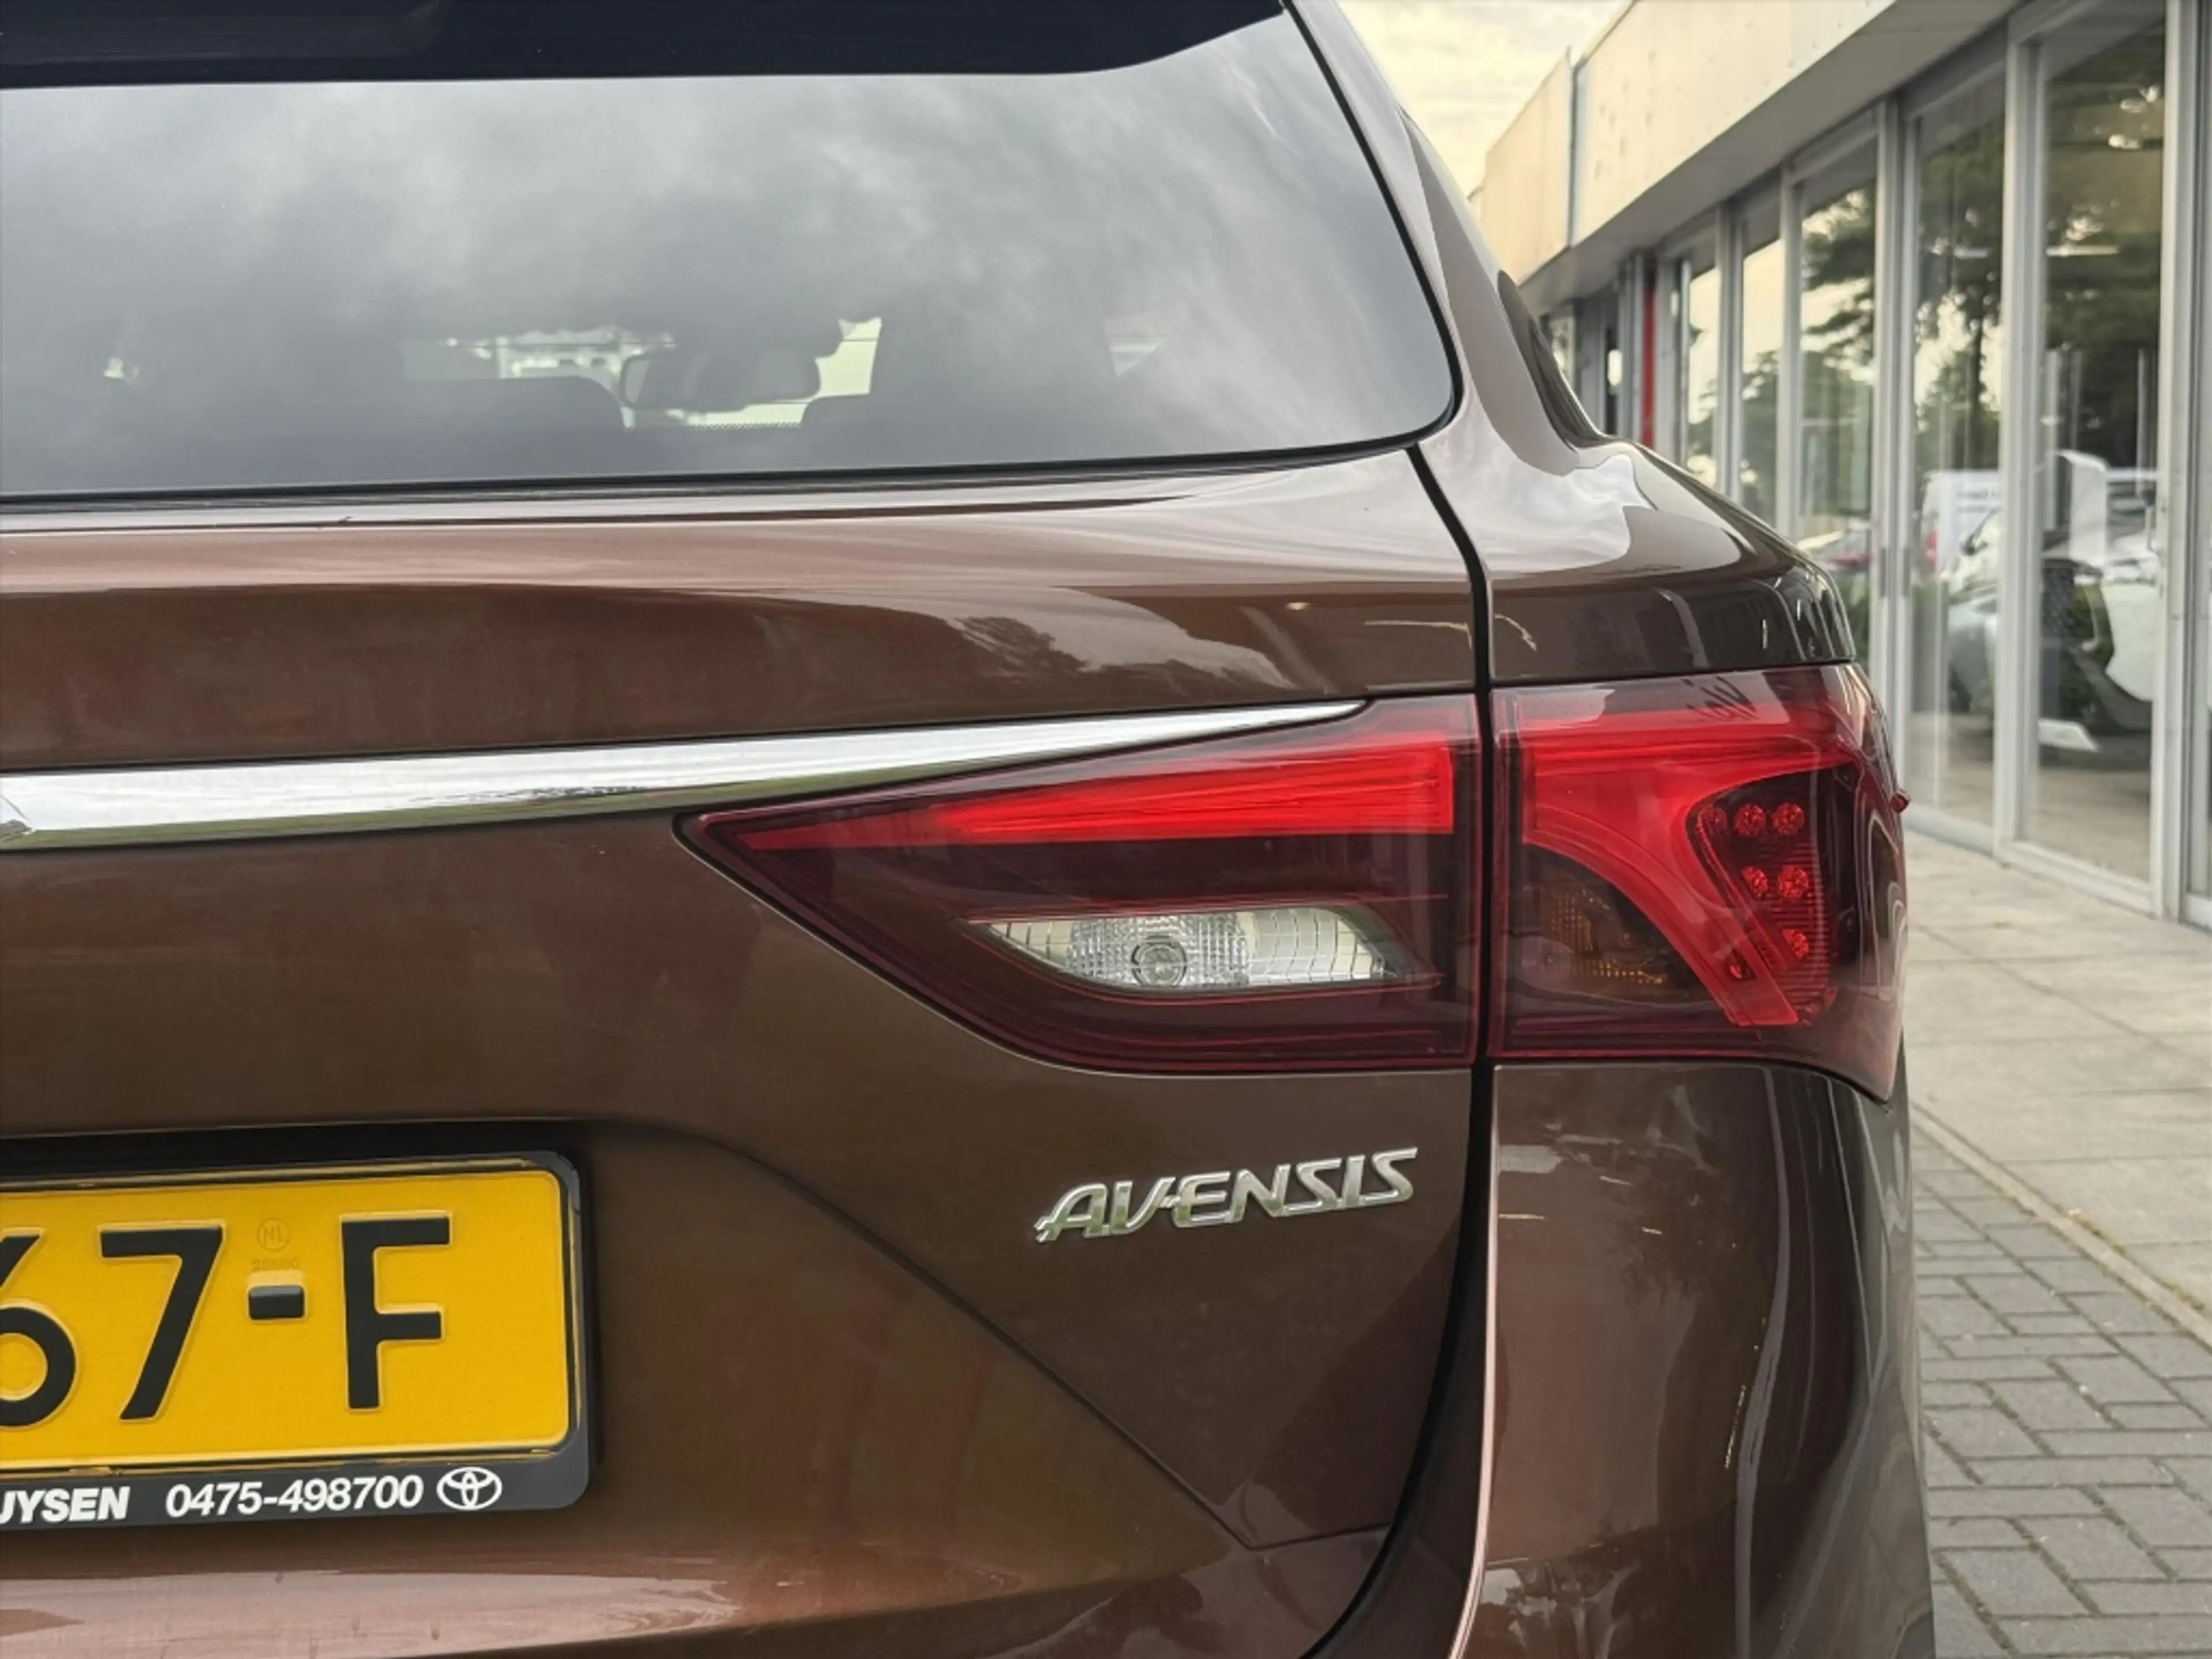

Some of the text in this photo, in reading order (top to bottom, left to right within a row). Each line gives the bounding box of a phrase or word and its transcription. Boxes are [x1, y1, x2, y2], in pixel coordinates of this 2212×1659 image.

[1035, 1147, 1418, 1242] AVENSIS
[0, 1216, 450, 1427] 67-F
[165, 1475, 424, 1517] 0475-498700
